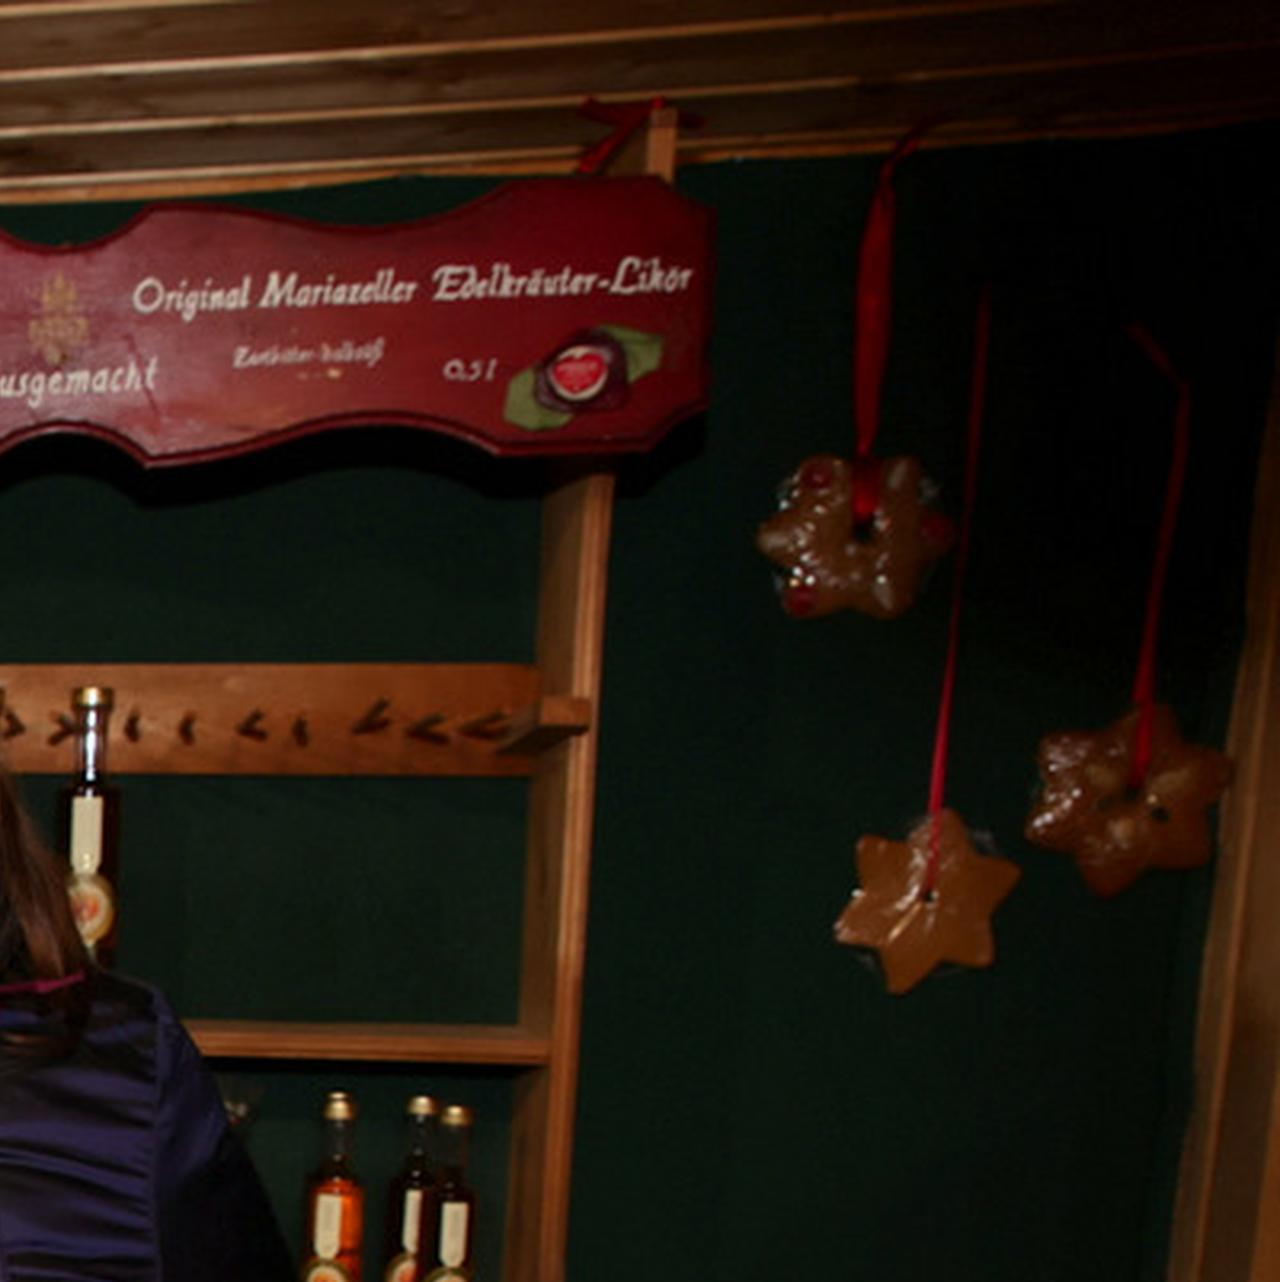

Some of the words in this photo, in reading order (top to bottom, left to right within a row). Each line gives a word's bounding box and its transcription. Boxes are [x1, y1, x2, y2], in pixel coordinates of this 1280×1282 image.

[132, 276, 250, 323] Original
[259, 270, 417, 311] Mariazeller
[432, 255, 693, 302] Edelkräuter-Likör
